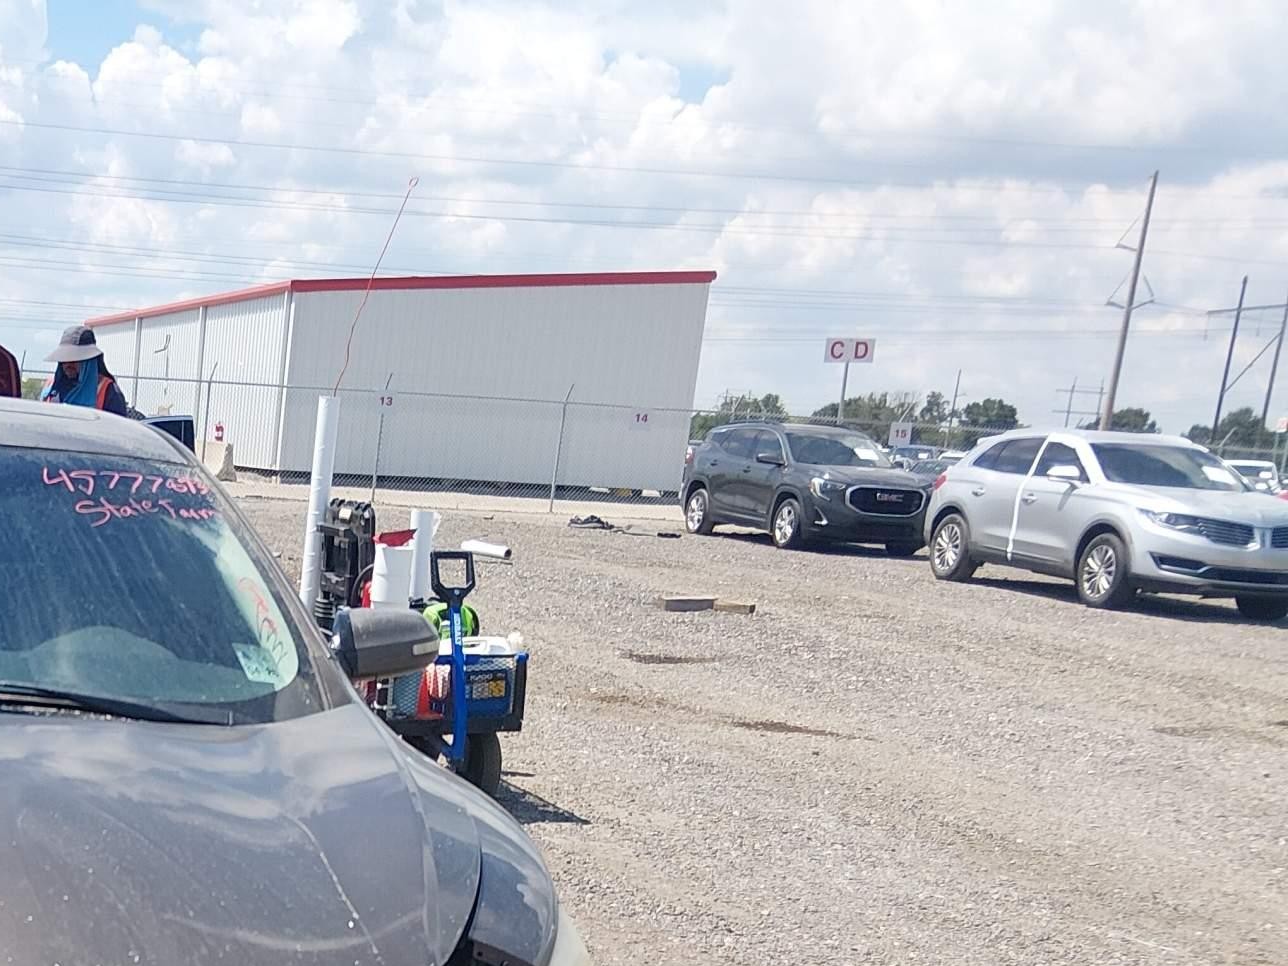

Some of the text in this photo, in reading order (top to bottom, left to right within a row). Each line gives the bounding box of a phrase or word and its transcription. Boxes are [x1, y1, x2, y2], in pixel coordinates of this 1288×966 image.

[830, 341, 869, 360] C D
[379, 396, 393, 407] 13
[635, 413, 649, 423] 14
[895, 429, 907, 439] 15
[876, 492, 904, 502] GMC
[75, 496, 159, 528] State
